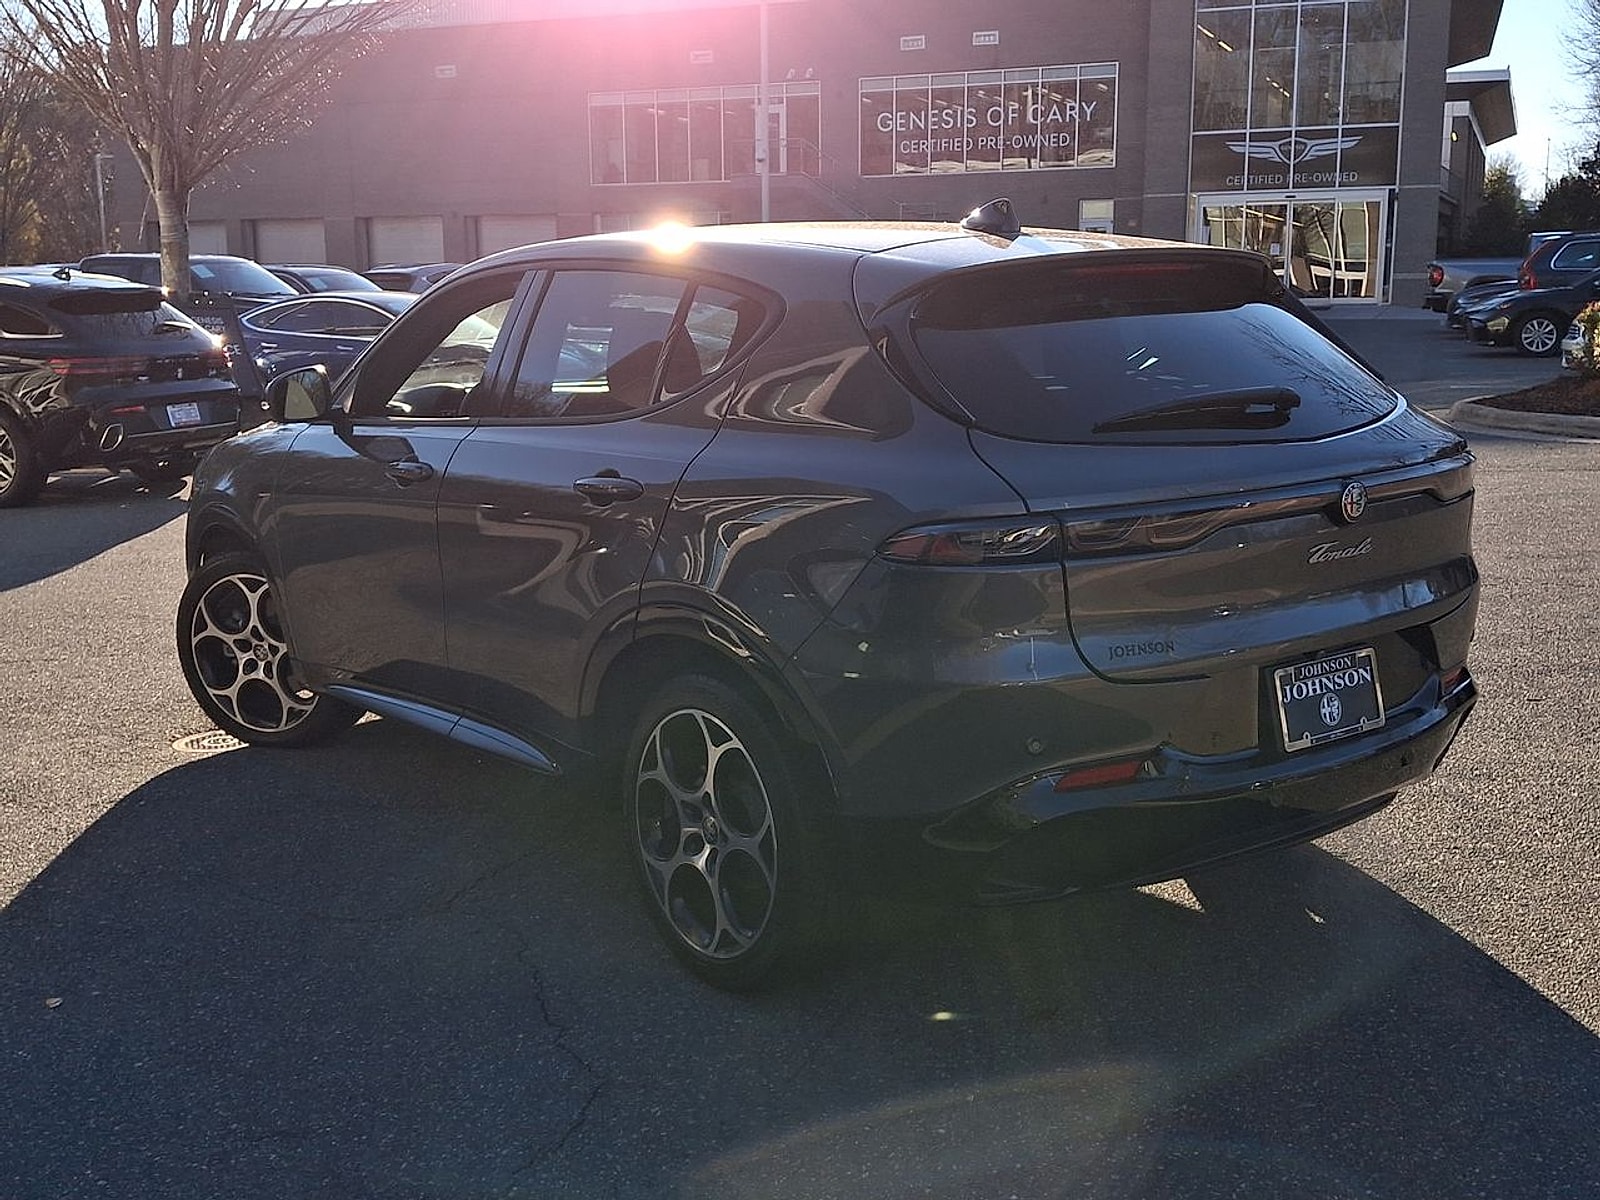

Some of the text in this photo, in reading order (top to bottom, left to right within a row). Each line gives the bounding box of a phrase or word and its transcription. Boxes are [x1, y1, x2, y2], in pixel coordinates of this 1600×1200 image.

[877, 101, 1097, 132] GENESIS OF CARY
[900, 132, 1070, 154] CERTIFIED PRE-OWNED
[1308, 537, 1373, 564] Tonale
[1108, 640, 1175, 660] JOHNSON
[1300, 656, 1353, 679] JOHNSON
[1283, 666, 1372, 704] JOHNSON
